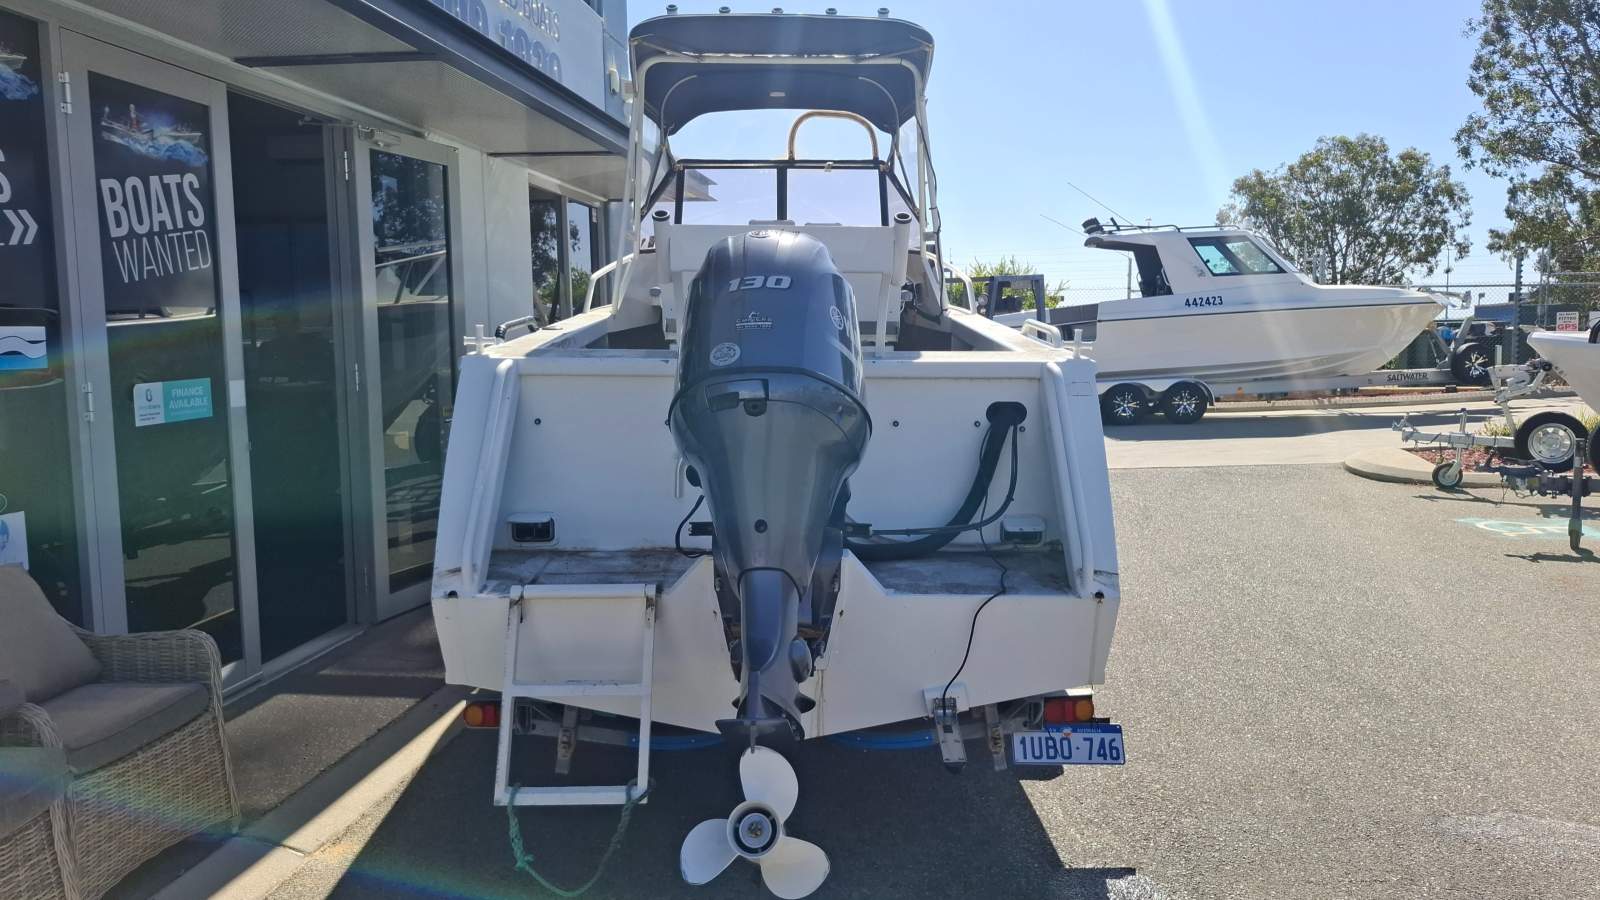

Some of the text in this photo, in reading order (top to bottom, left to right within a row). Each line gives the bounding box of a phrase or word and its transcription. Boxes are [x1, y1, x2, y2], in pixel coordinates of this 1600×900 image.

[100, 172, 205, 238] BOATS
[112, 229, 212, 284] WANTED
[728, 275, 791, 292] 130
[1185, 296, 1223, 307] 442423
[1386, 373, 1428, 381] SALTWATER
[171, 386, 204, 399] FINANCE
[169, 396, 209, 409] AVAILABLE
